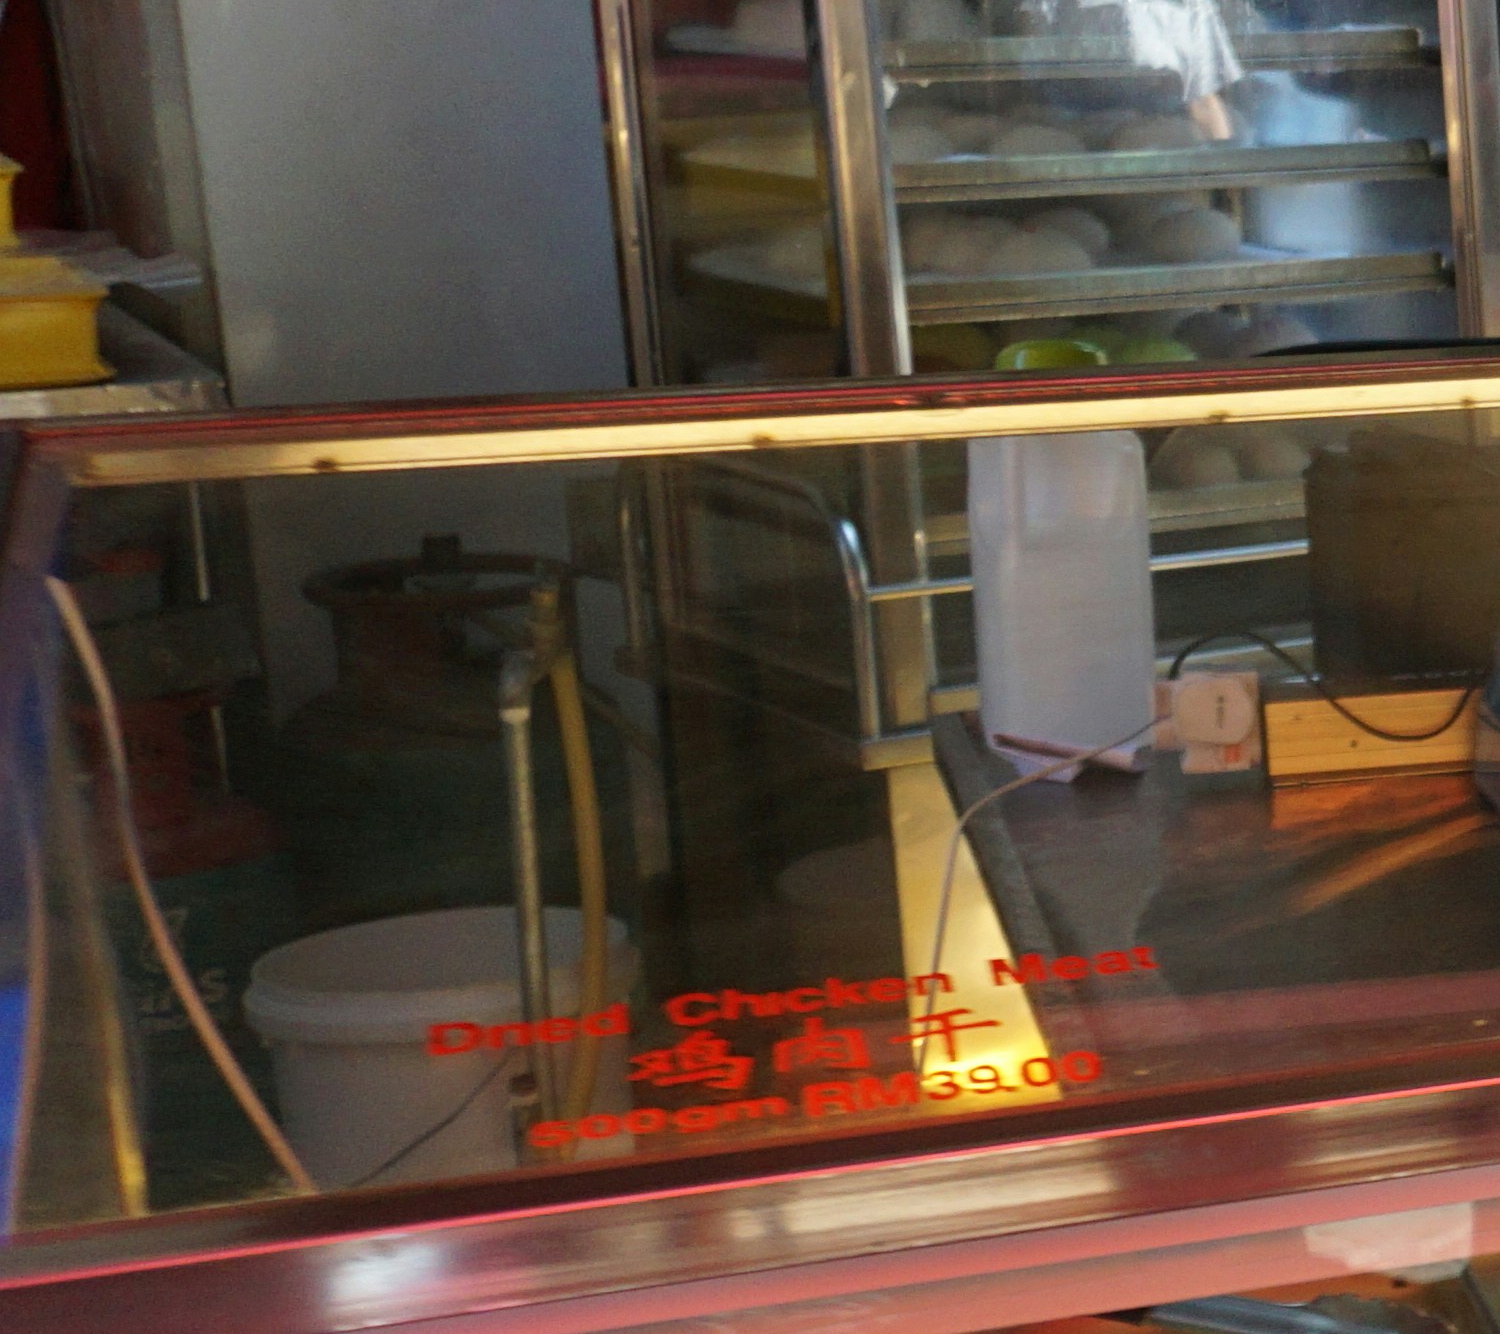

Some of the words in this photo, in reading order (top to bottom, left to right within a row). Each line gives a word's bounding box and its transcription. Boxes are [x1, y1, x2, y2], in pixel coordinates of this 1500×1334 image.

[426, 1002, 631, 1058] Dried
[665, 970, 955, 1029] Chicken
[988, 945, 1160, 988] Meat
[627, 1007, 1002, 1092] 鸡肉干
[528, 1095, 792, 1150] 500gm
[799, 1049, 1104, 1121] RM39.00
